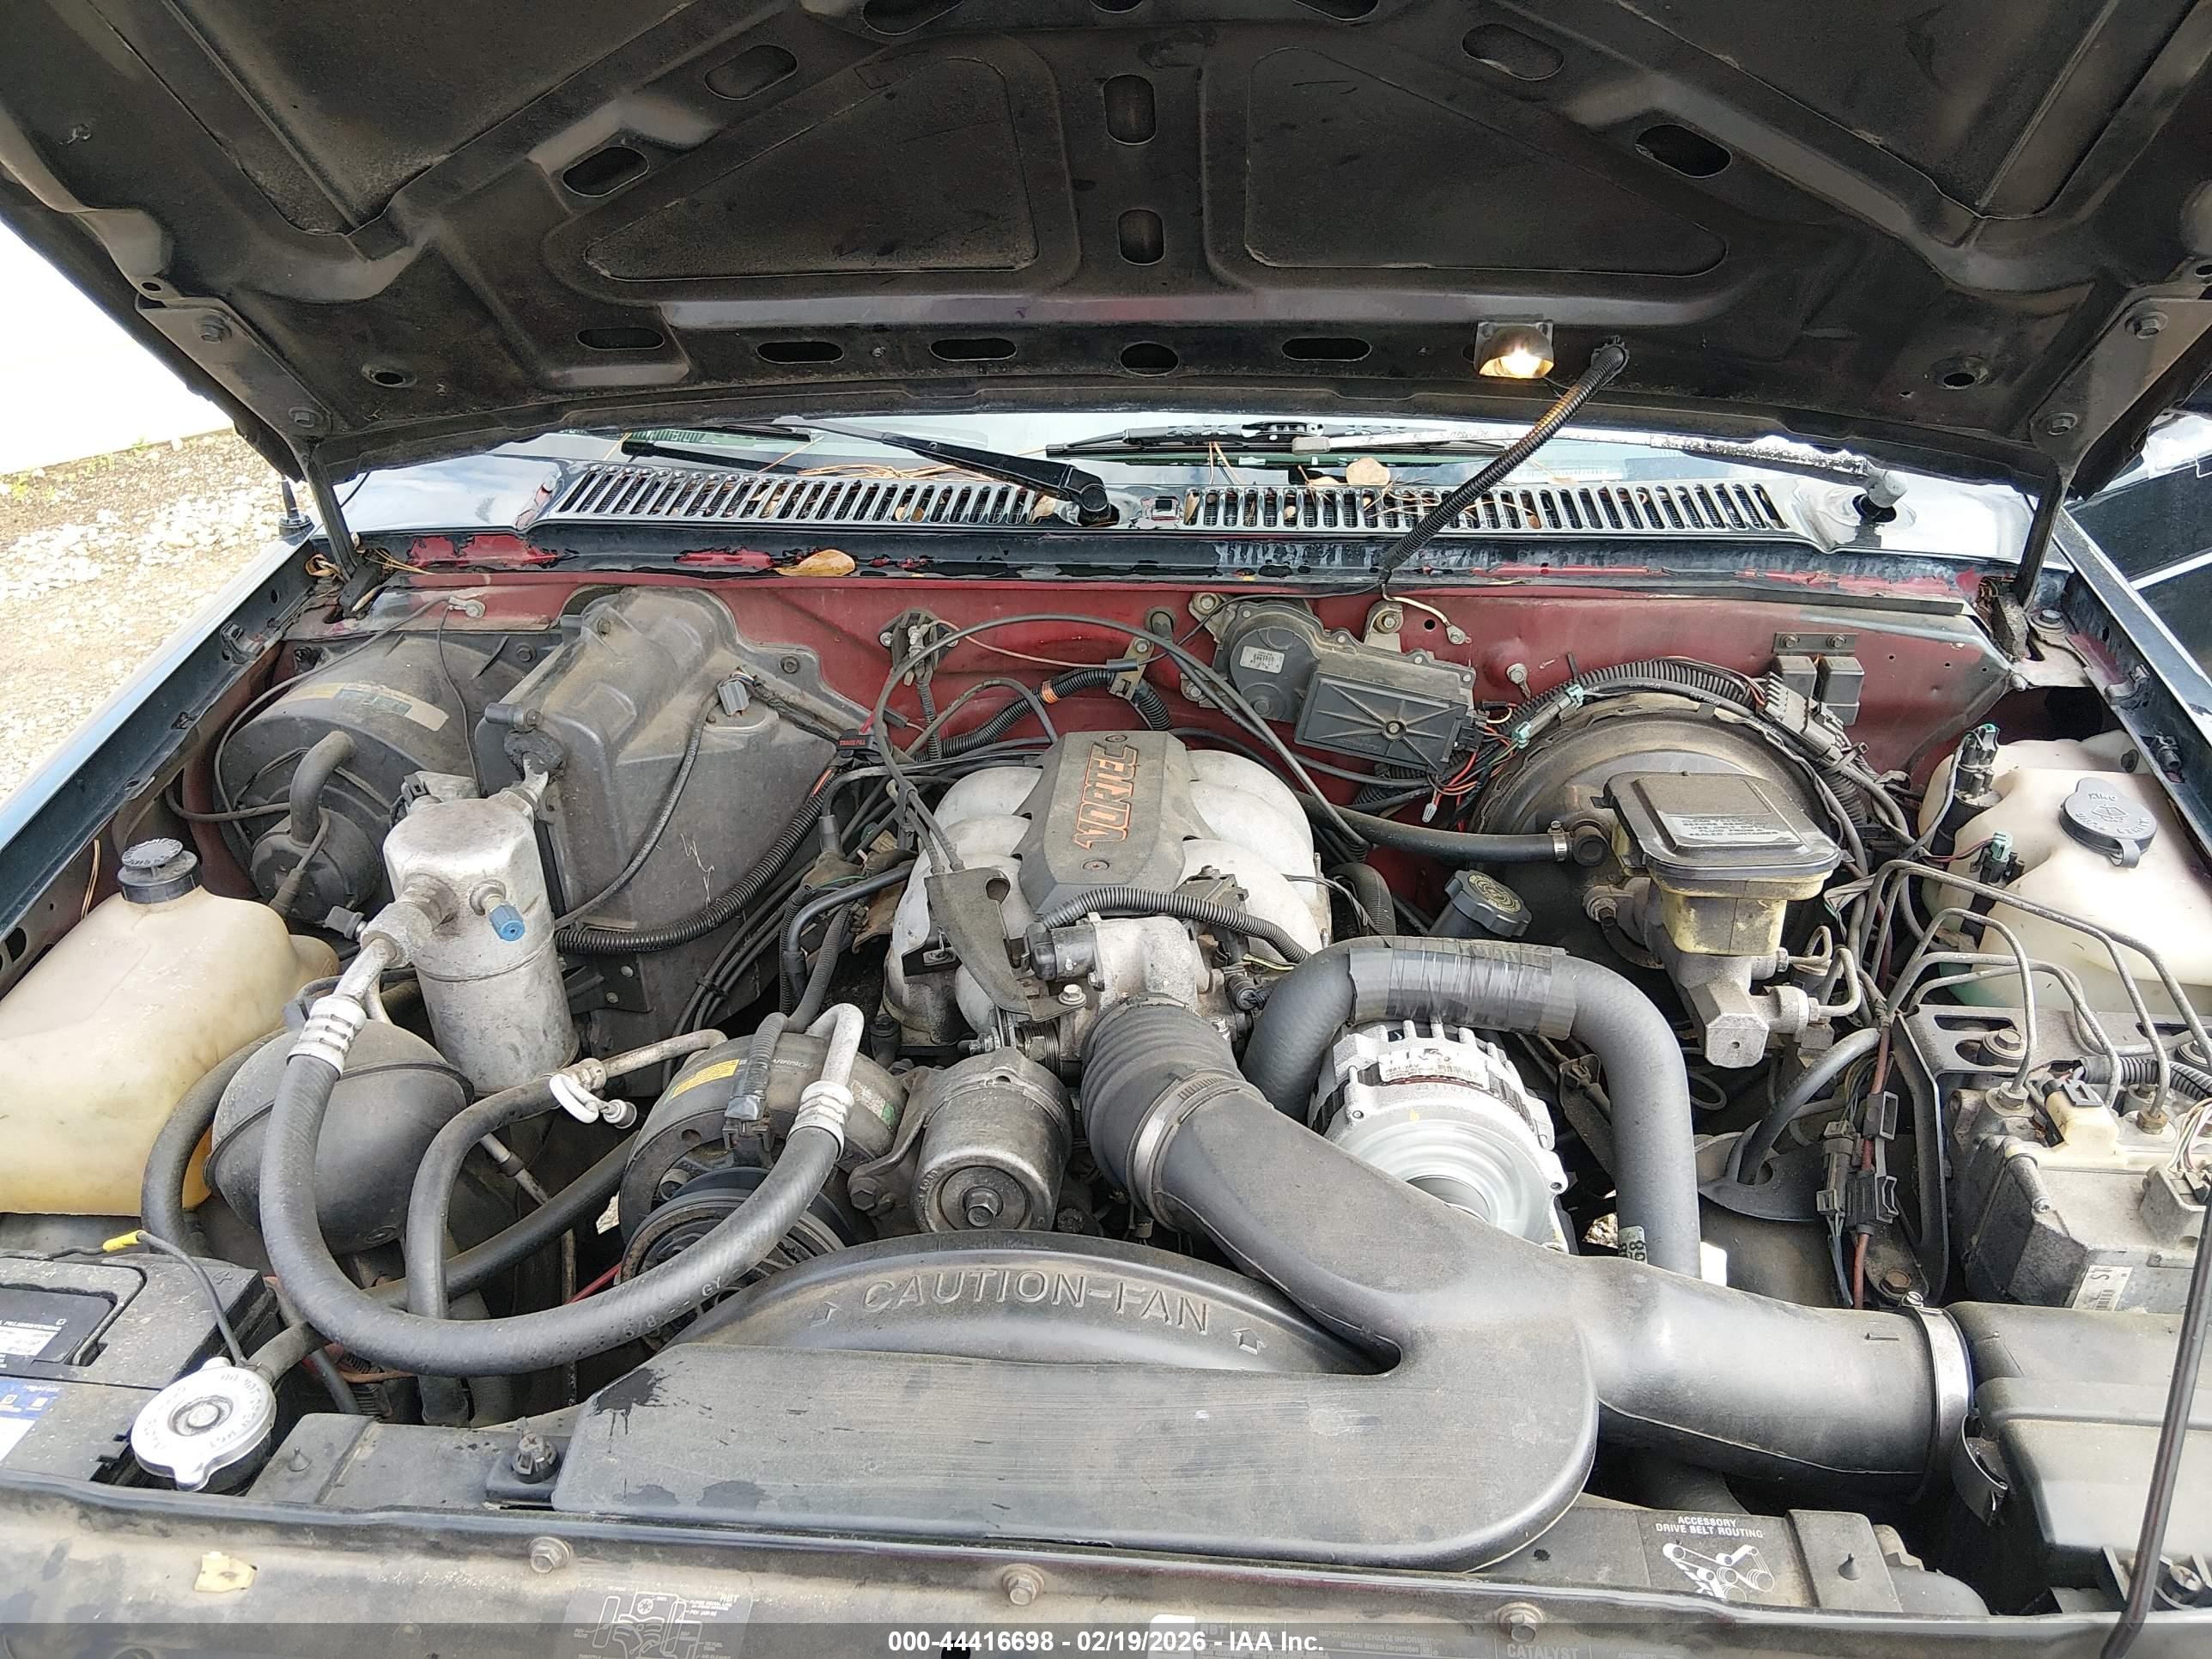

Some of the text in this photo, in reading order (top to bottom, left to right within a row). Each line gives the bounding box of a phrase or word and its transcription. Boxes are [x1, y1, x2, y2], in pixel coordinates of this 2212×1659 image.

[1073, 742, 1138, 851] VORTEC
[1678, 1516, 1736, 1528] ACCESSORY
[1656, 1522, 1765, 1539] DRIVE BELT ROUTING
[1506, 1644, 1579, 1659] CATALYST
